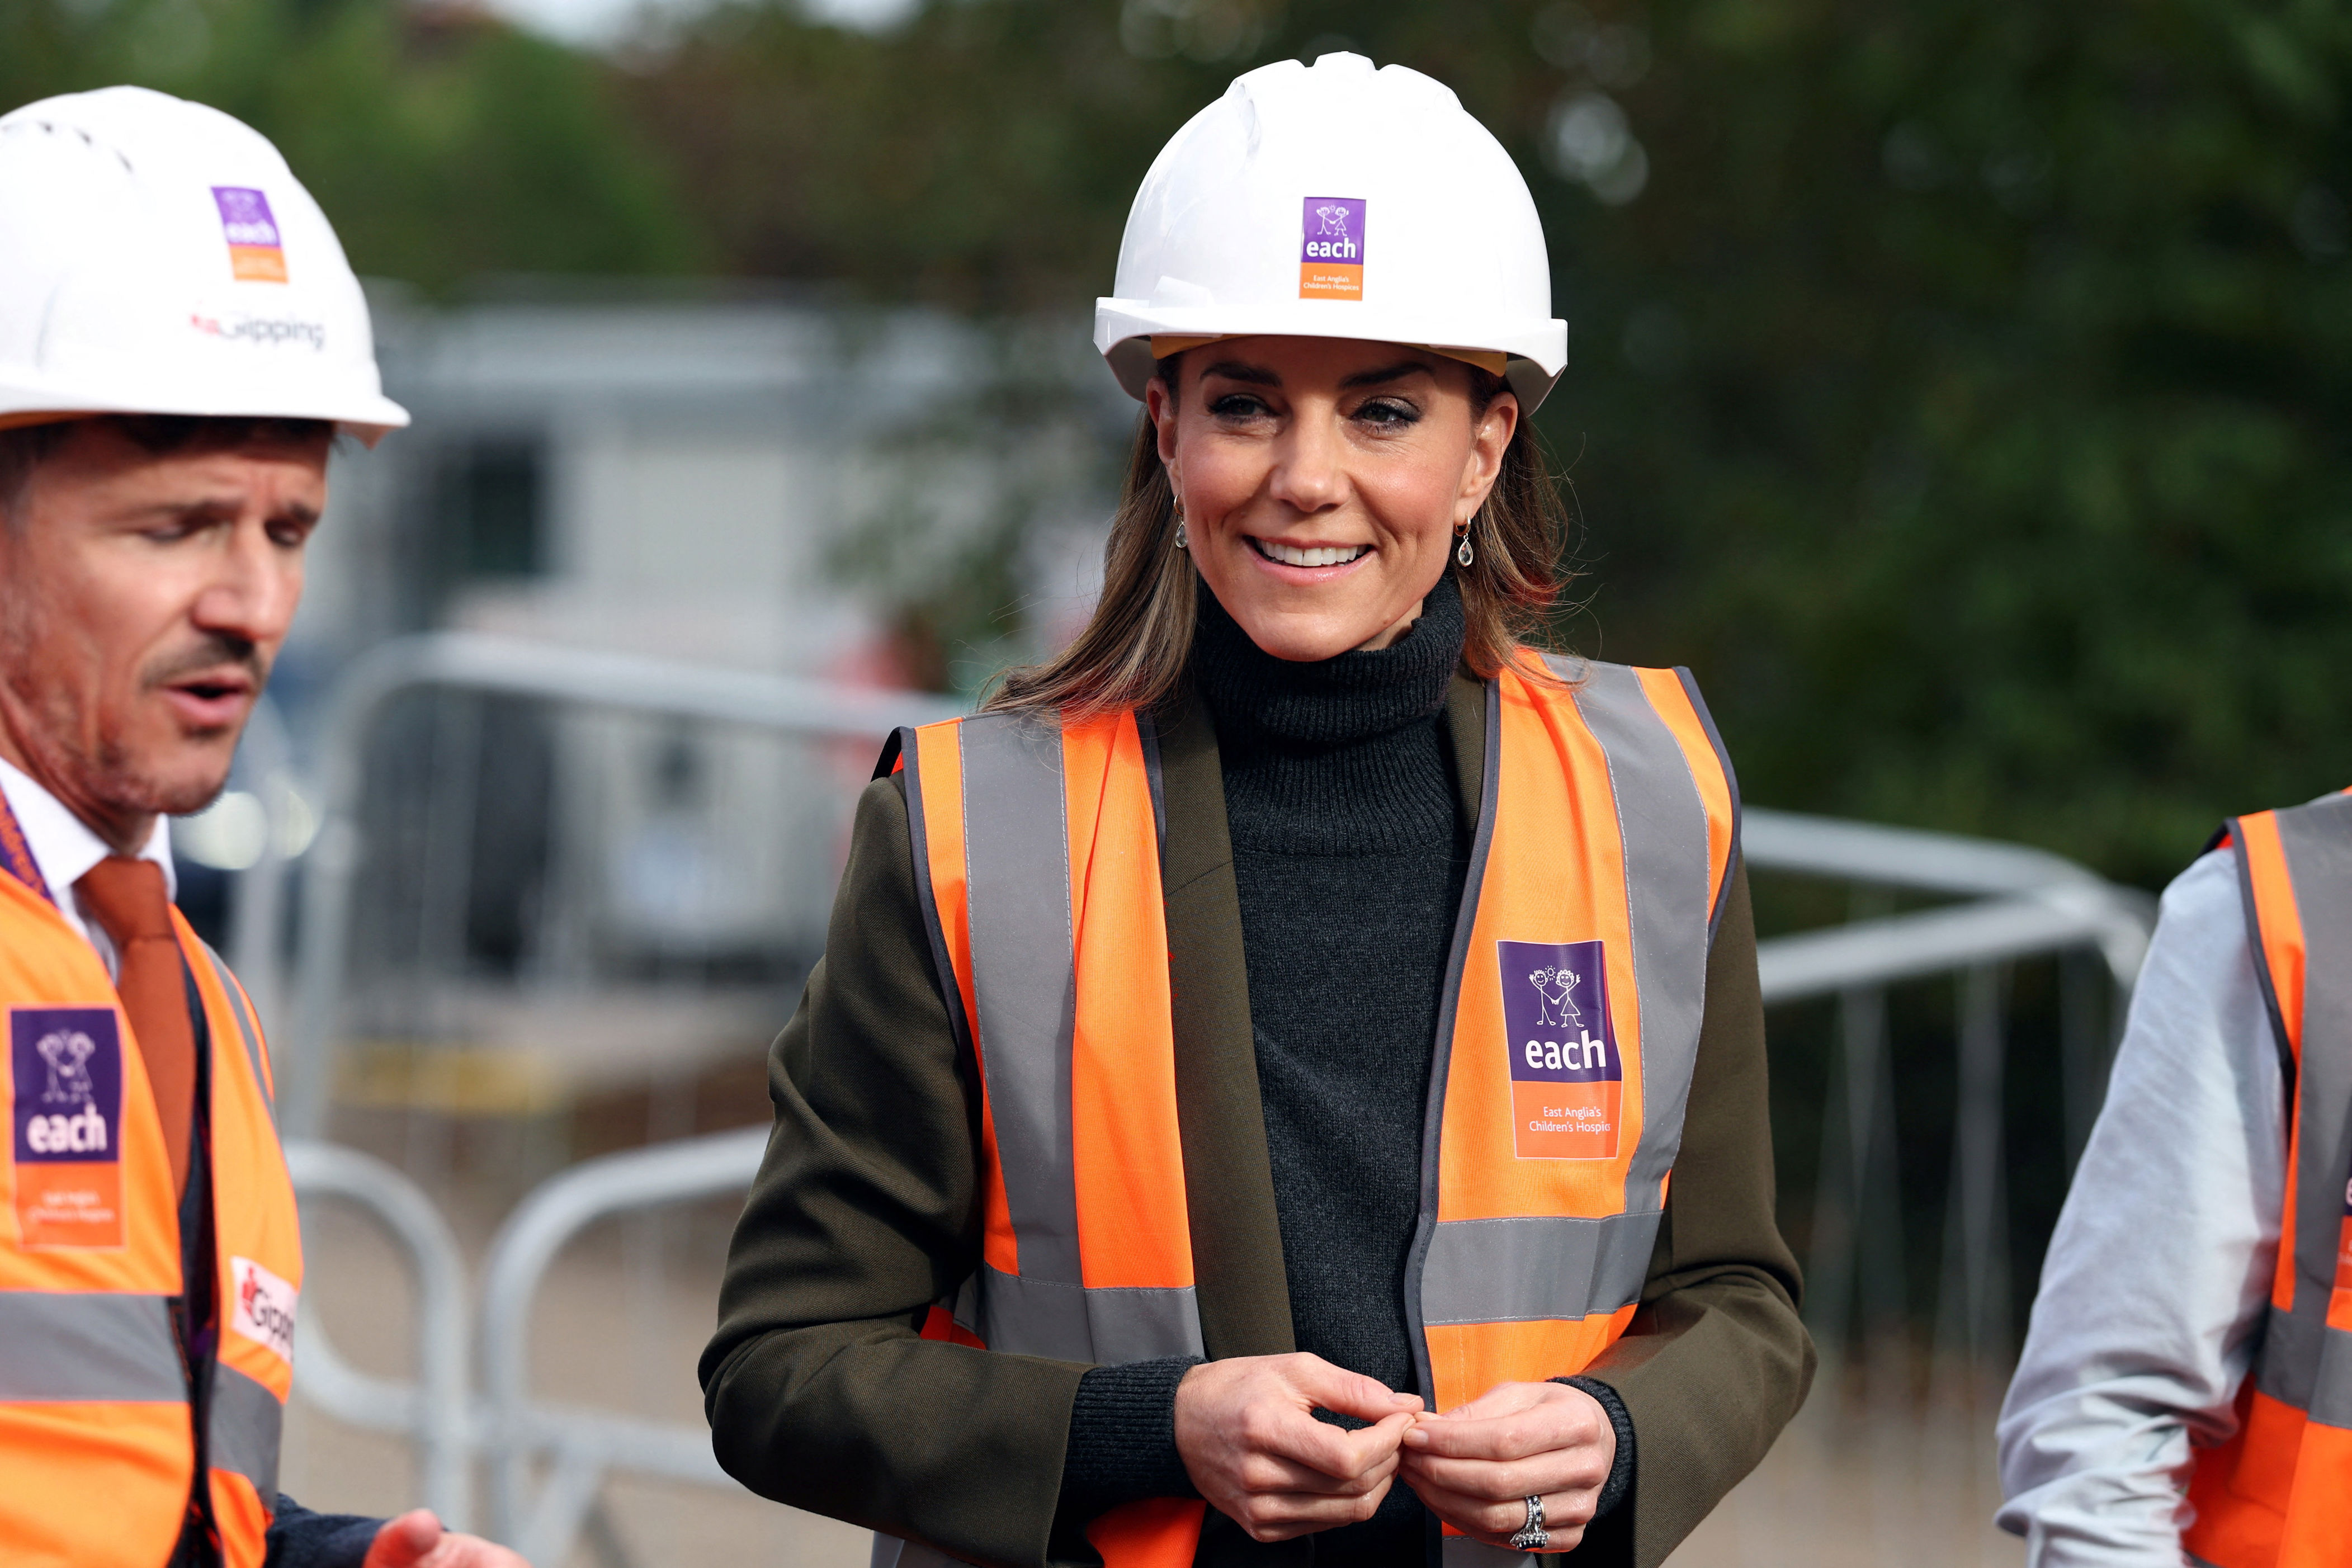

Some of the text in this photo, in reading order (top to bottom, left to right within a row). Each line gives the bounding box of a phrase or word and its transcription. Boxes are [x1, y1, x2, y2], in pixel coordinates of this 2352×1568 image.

[1306, 237, 1356, 258] each
[1525, 1029, 1606, 1070] each
[1543, 1106, 1602, 1120] East Anglia's
[27, 1102, 107, 1153] each
[1529, 1120, 1574, 1132] Children's
